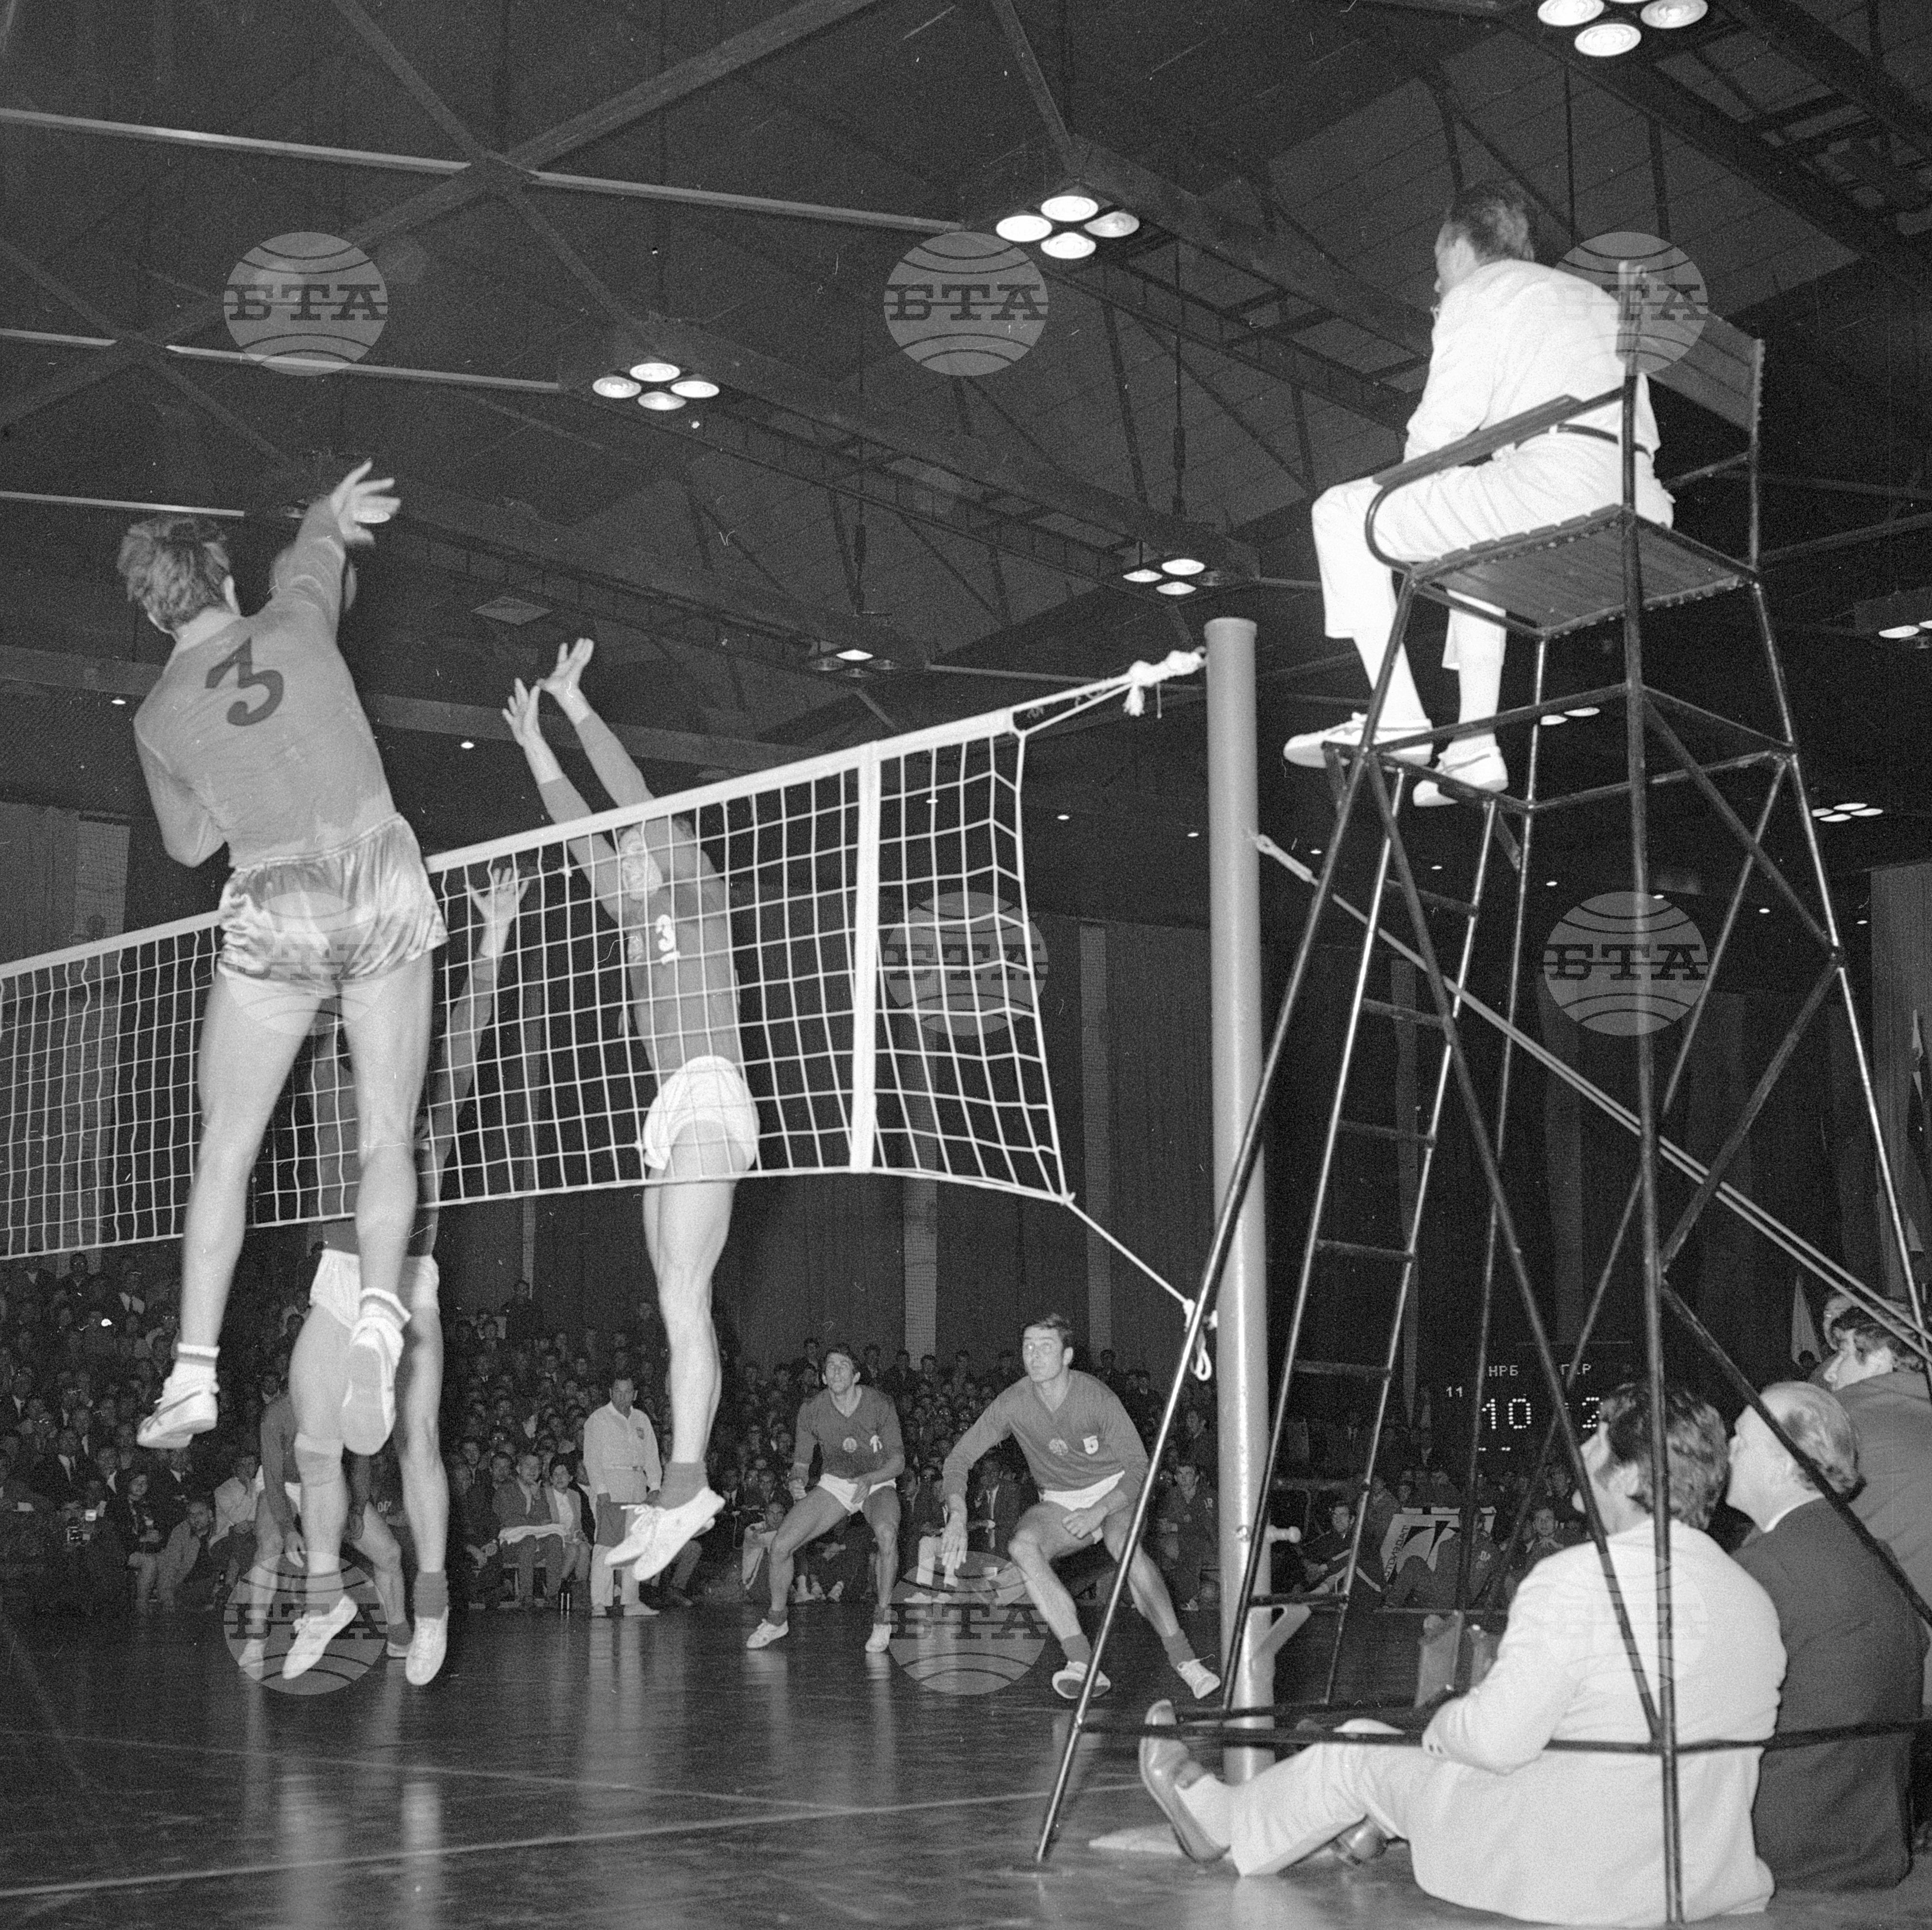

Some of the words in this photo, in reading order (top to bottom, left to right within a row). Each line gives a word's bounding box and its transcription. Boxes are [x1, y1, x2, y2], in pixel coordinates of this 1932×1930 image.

[205, 637, 284, 726] 3
[655, 914, 676, 952] 3
[1489, 1365, 1518, 1377] НРБ
[1561, 1363, 1591, 1375] ГР
[1446, 1386, 1463, 1397] 11
[1481, 1398, 1531, 1429] 10
